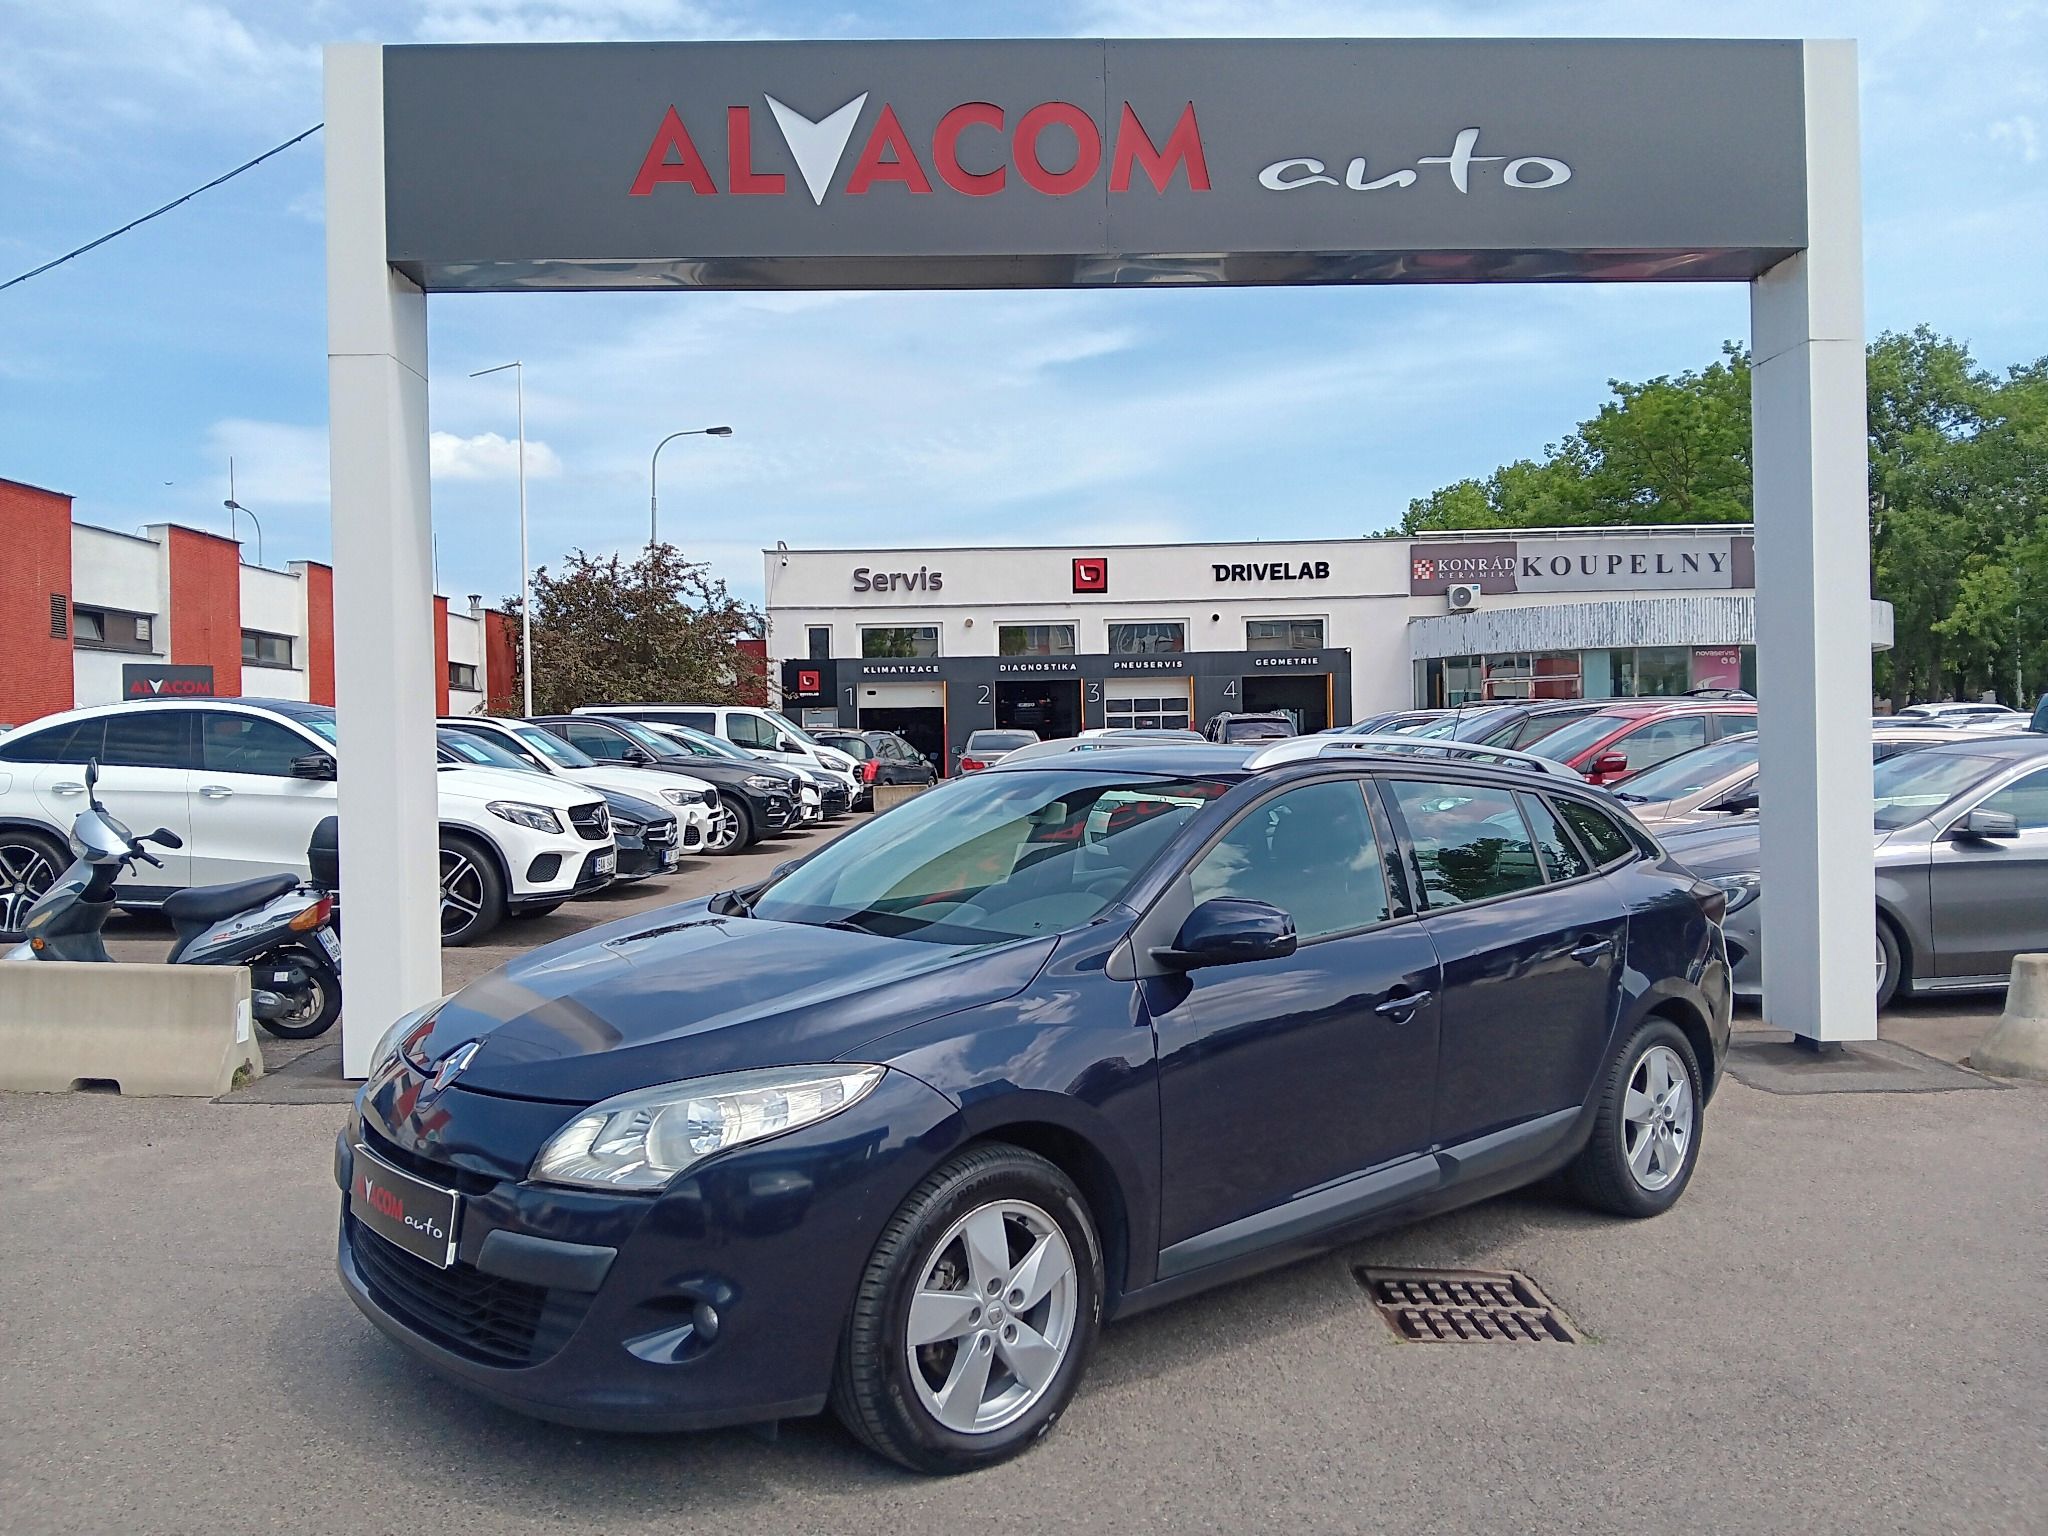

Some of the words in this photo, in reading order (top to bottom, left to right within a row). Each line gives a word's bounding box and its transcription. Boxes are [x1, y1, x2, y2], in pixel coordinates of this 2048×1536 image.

[629, 91, 1213, 206] ALVACOM
[1257, 126, 1572, 195] auto
[1212, 561, 1330, 582] DRIVELAB
[1438, 555, 1516, 571] KONRÁD
[1521, 552, 1728, 577] KOUPELNY
[853, 566, 943, 592] Servis
[1438, 571, 1516, 579] KERAMIKA
[863, 665, 940, 674] KLIMATIZACE
[1000, 663, 1077, 672] DIAGNOSTIKA
[1114, 660, 1184, 669] PNEUSERVIS
[1255, 657, 1319, 666] GEOMETRIE
[130, 679, 211, 694] ALVACOM
[977, 685, 990, 705] 2
[1087, 683, 1100, 703] 3
[1223, 680, 1238, 699] 4
[844, 687, 853, 707] 1
[404, 1217, 443, 1239] auto
